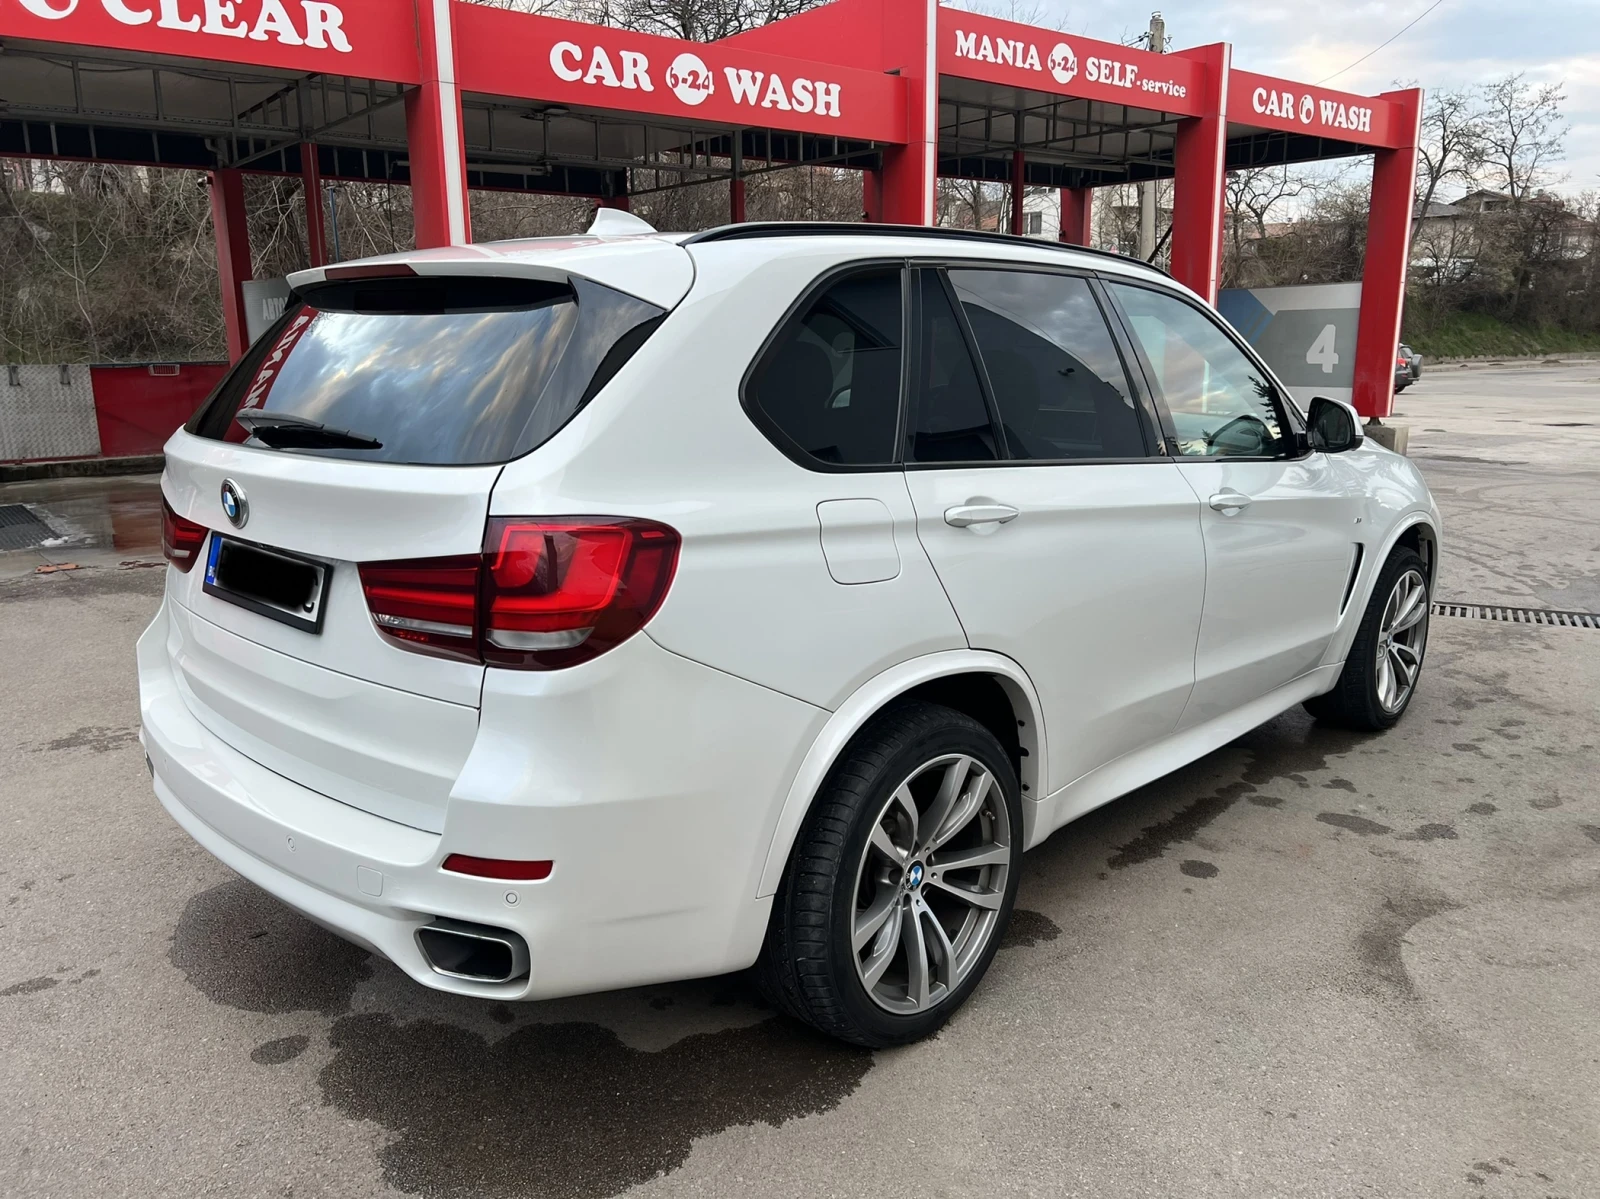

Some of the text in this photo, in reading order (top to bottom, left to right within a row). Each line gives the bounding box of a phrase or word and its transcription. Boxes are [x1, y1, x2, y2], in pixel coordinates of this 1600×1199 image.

[954, 29, 1042, 71] MANIA
[549, 41, 654, 91] CAR
[723, 67, 841, 117] WASH
[1252, 87, 1295, 119] CAR
[1319, 99, 1372, 132] WASH
[1305, 323, 1340, 374] 4
